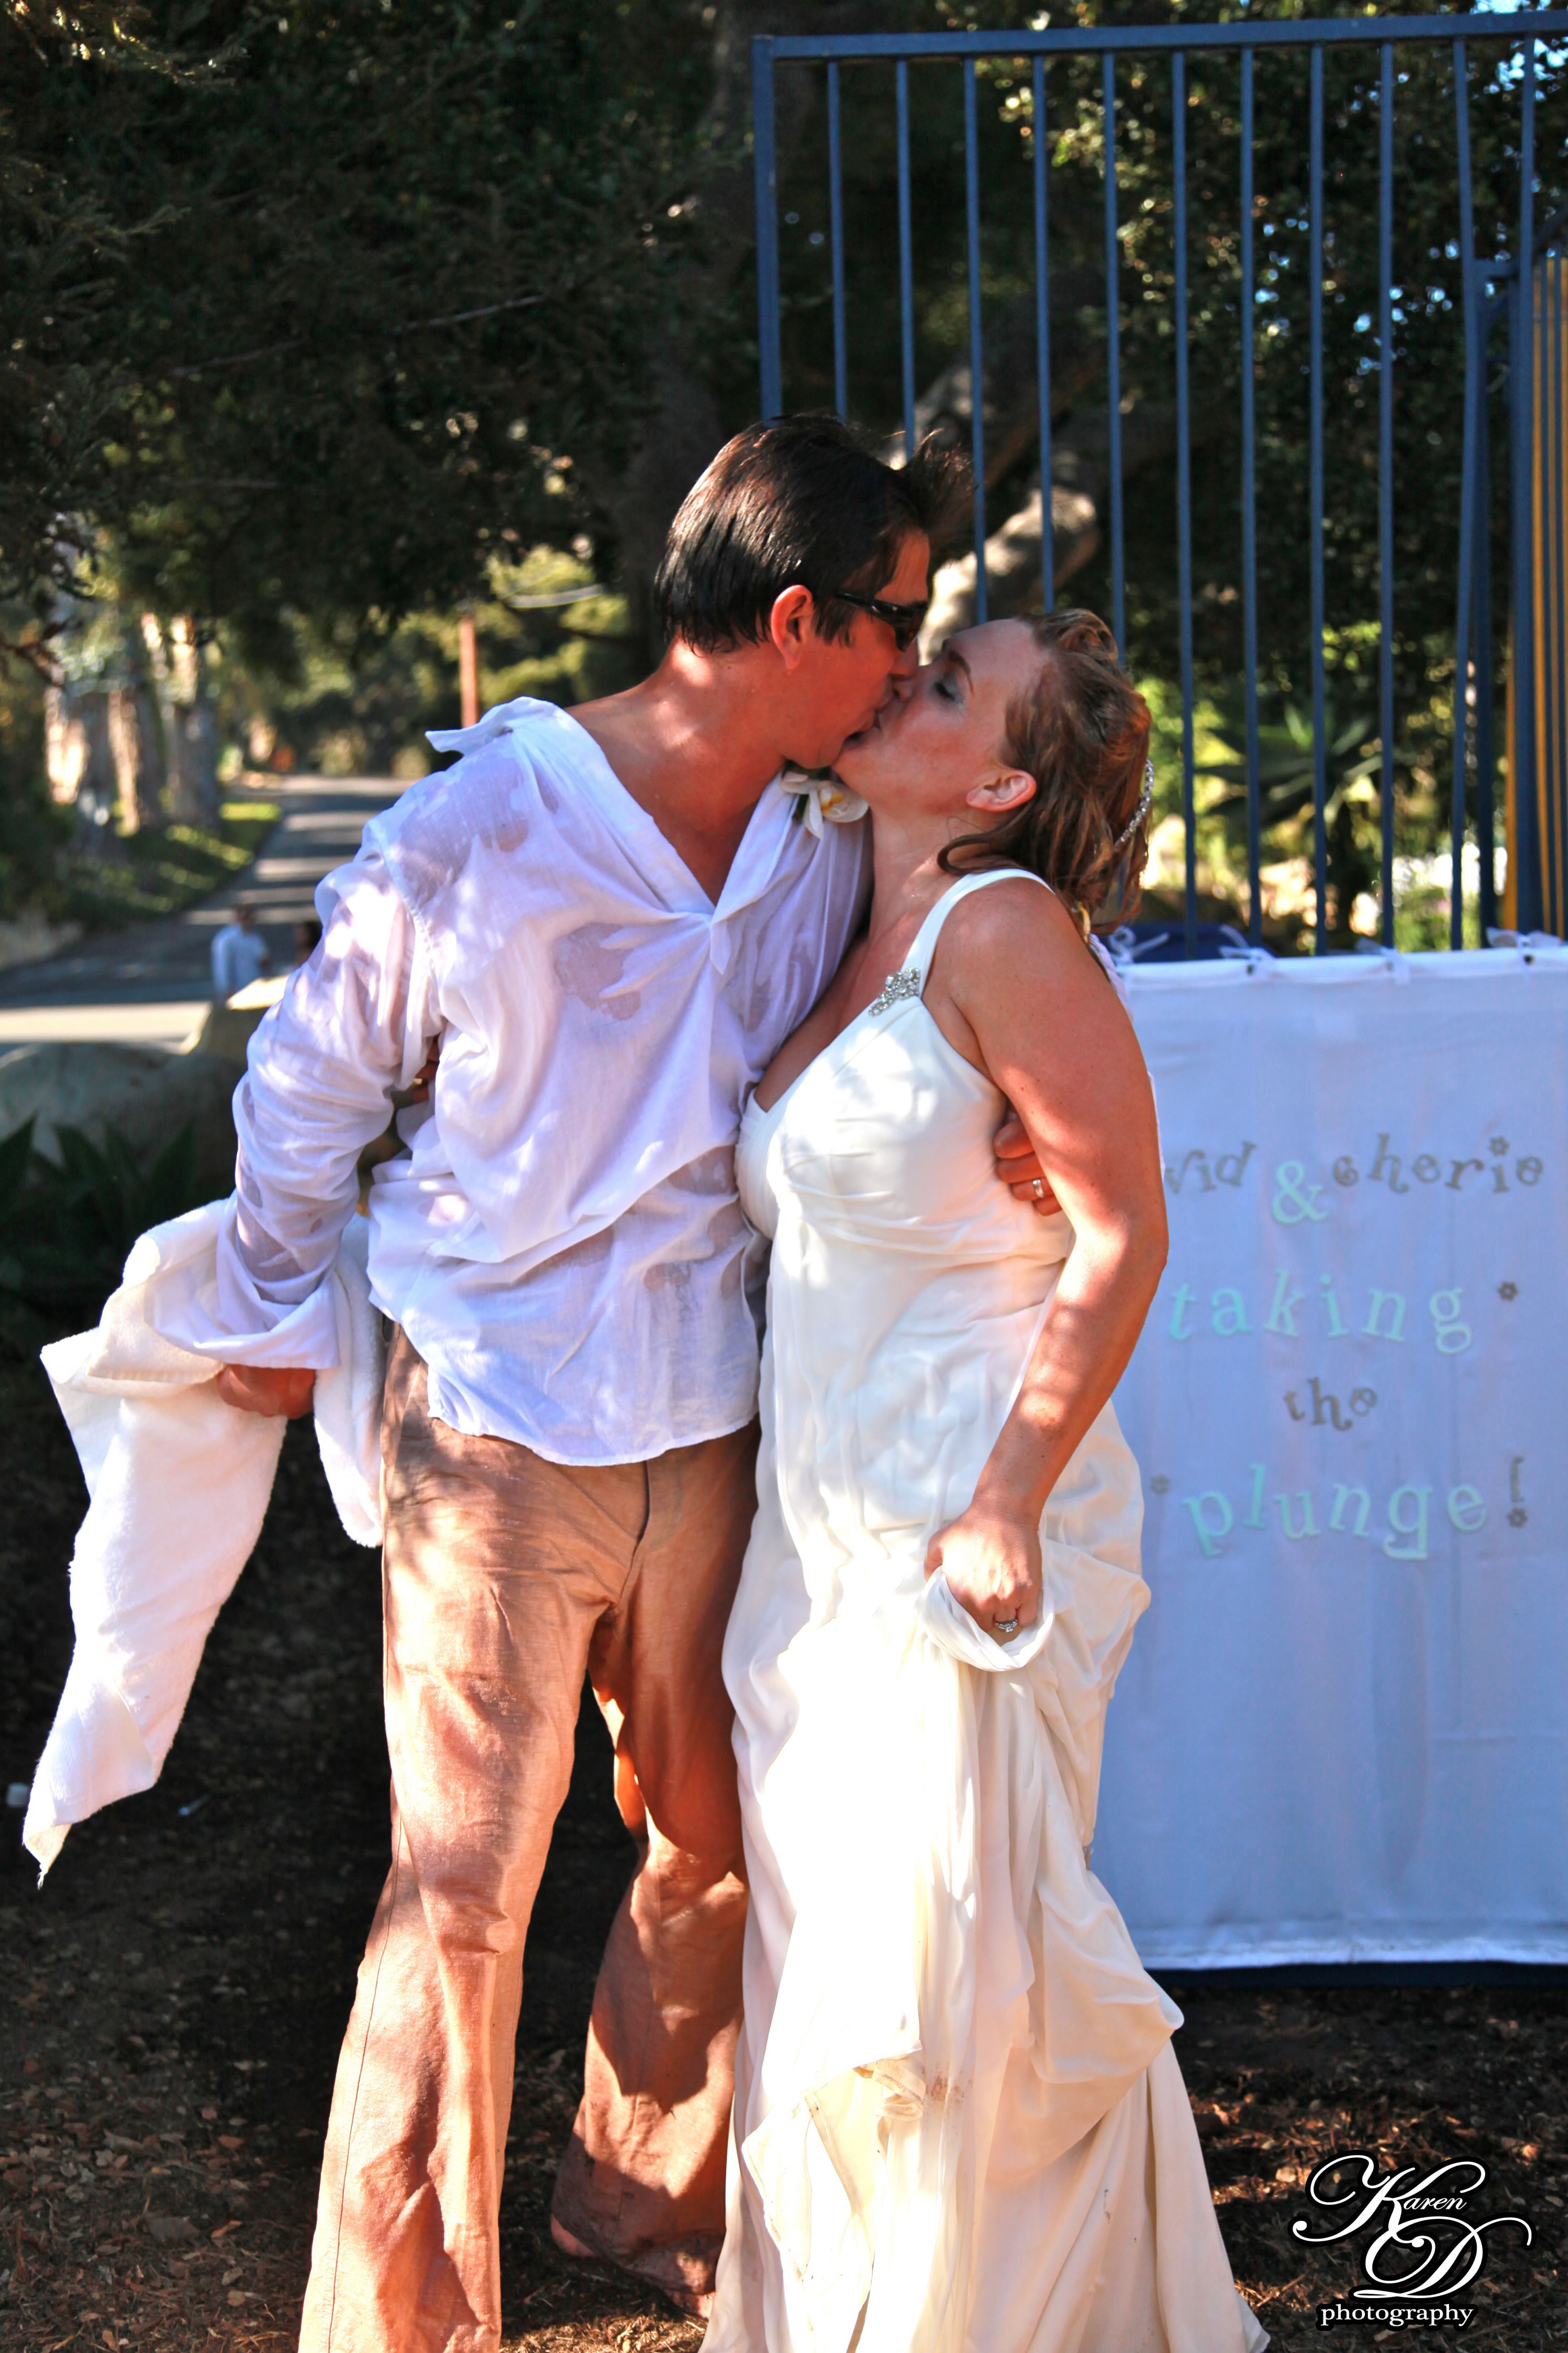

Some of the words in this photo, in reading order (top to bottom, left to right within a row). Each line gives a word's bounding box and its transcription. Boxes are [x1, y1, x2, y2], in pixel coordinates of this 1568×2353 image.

[1272, 1160, 1328, 1224] &
[1333, 1132, 1544, 1194] cherie
[1170, 1268, 1472, 1355] taking
[1283, 1376, 1377, 1431] the
